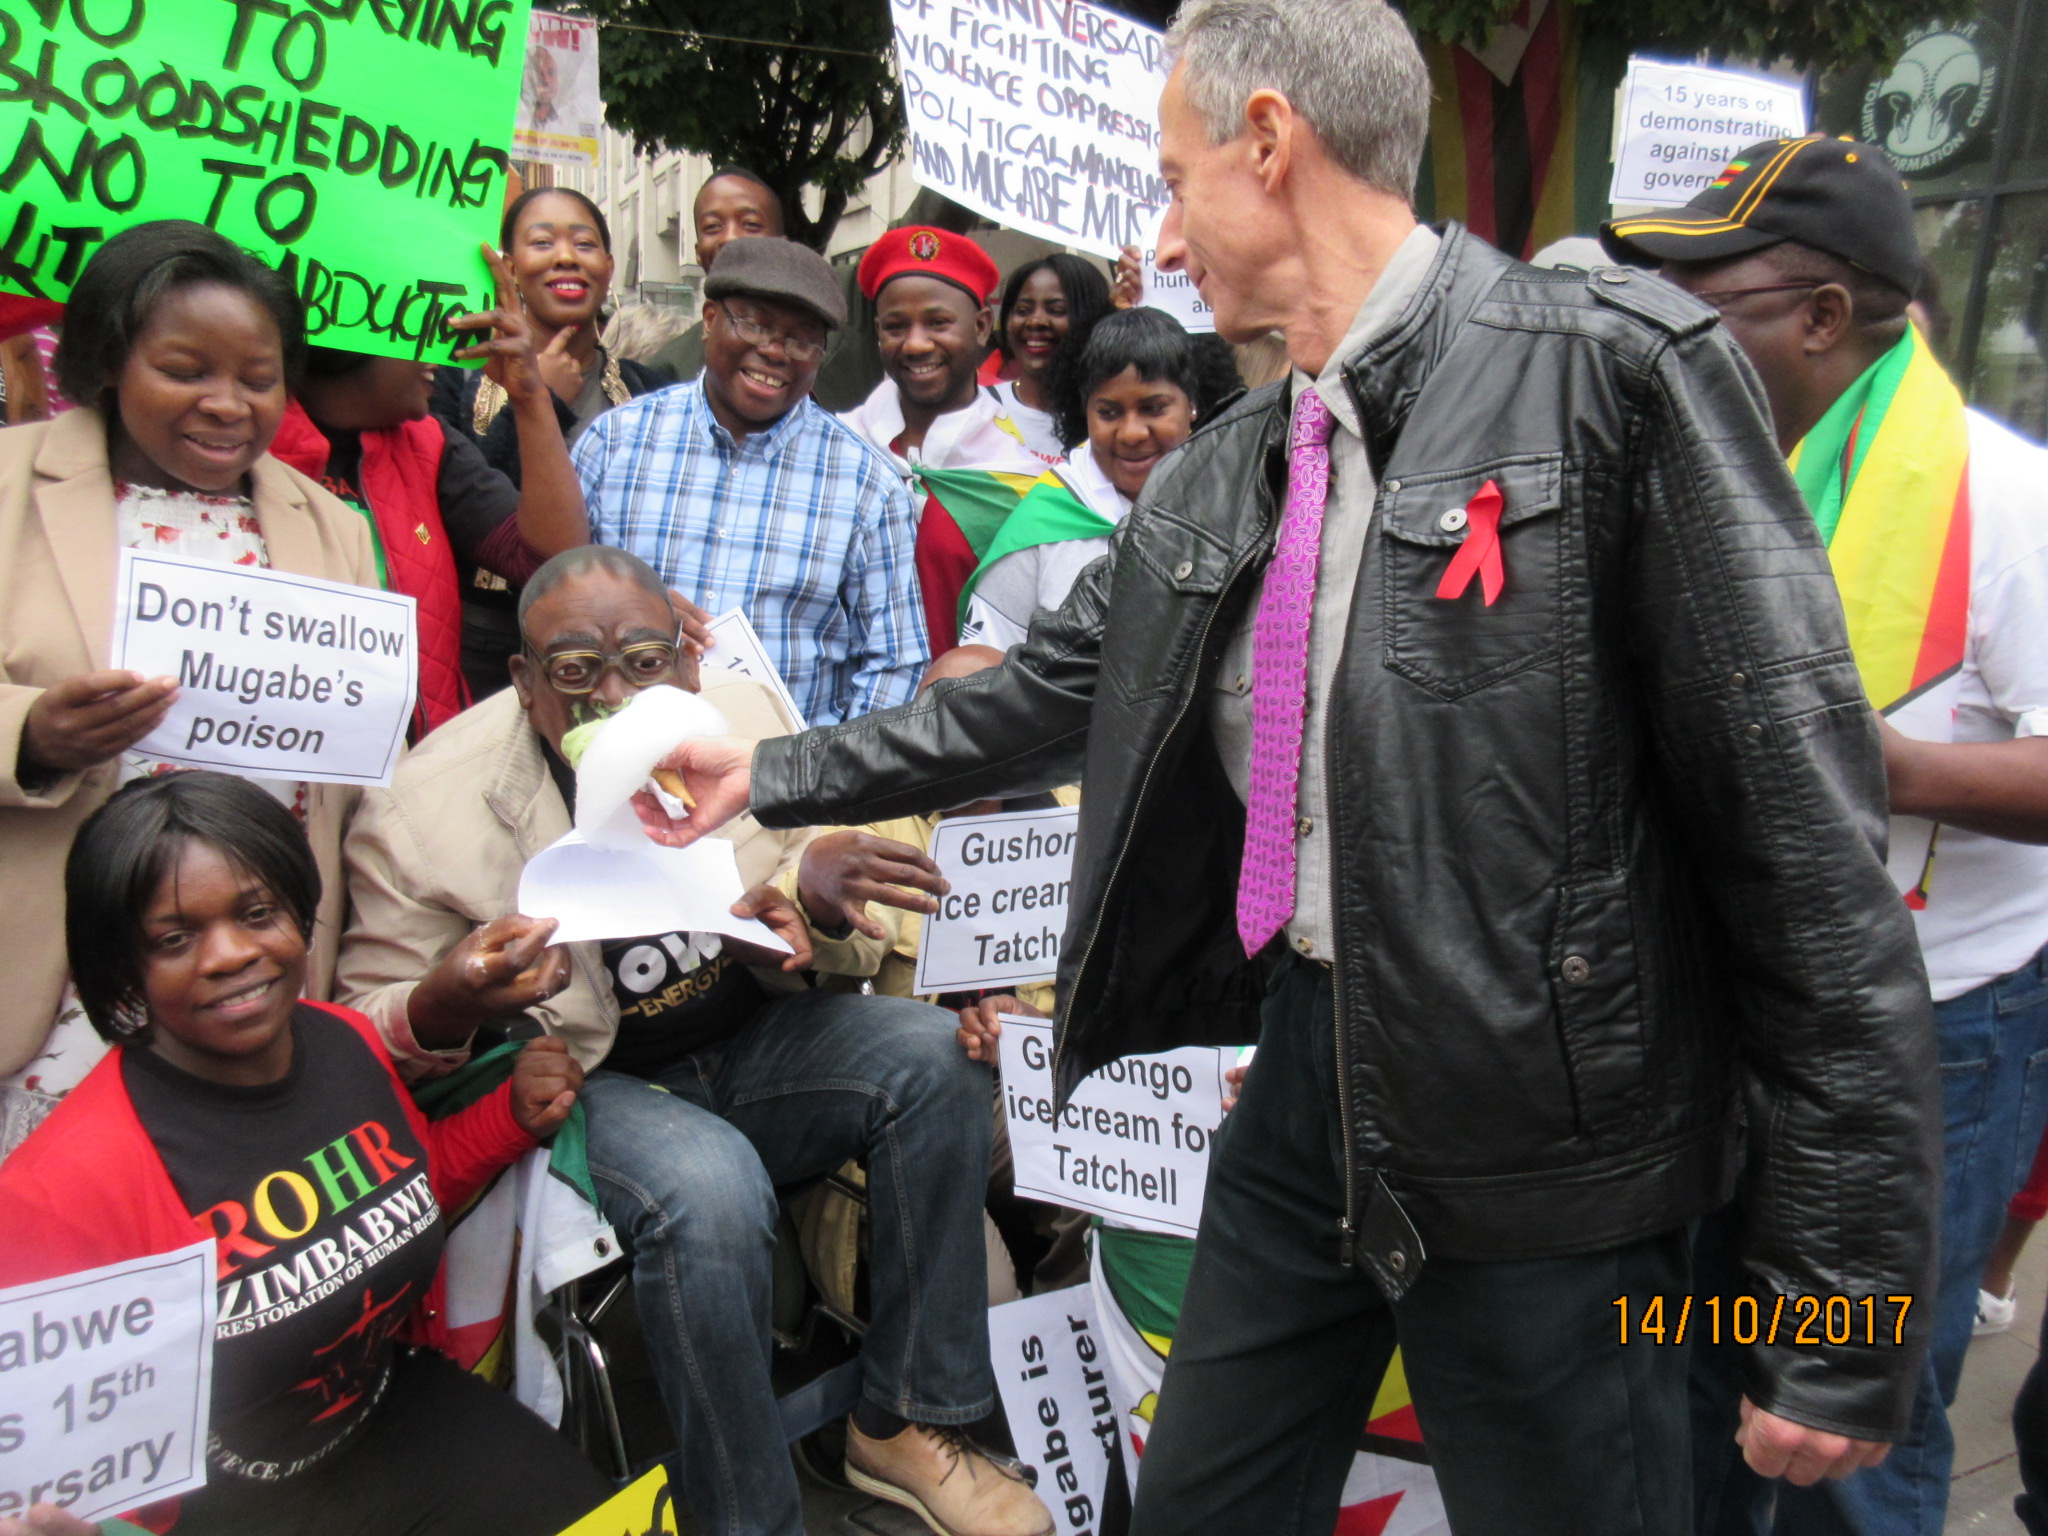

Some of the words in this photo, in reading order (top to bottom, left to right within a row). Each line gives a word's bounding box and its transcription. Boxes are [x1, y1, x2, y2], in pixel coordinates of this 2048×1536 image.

[895, 24, 1023, 107] VIOLENCE
[950, 6, 1111, 88] FIGHTING
[904, 68, 1071, 168] POLITICAL
[1664, 85, 1687, 103] 15
[1694, 91, 1749, 109] years
[1756, 99, 1774, 113] of
[0, 116, 147, 214] NO
[202, 158, 317, 244] TO
[913, 132, 955, 186] AND
[1650, 142, 1730, 163] against
[136, 582, 252, 636] Don't
[264, 610, 404, 658] swallow
[179, 649, 365, 707] Mugabe's
[186, 715, 325, 754] poison
[975, 926, 1065, 966] Tatch
[1008, 1085, 1054, 1124] ice
[1064, 1102, 1160, 1145] cream
[194, 1121, 417, 1280] ROHR
[1053, 1144, 1178, 1207] Tatchell
[216, 1172, 435, 1325] ZIMBABWE
[216, 1272, 346, 1341] RESTORATION
[344, 1261, 364, 1281] OF
[361, 1226, 414, 1269] HUMAN
